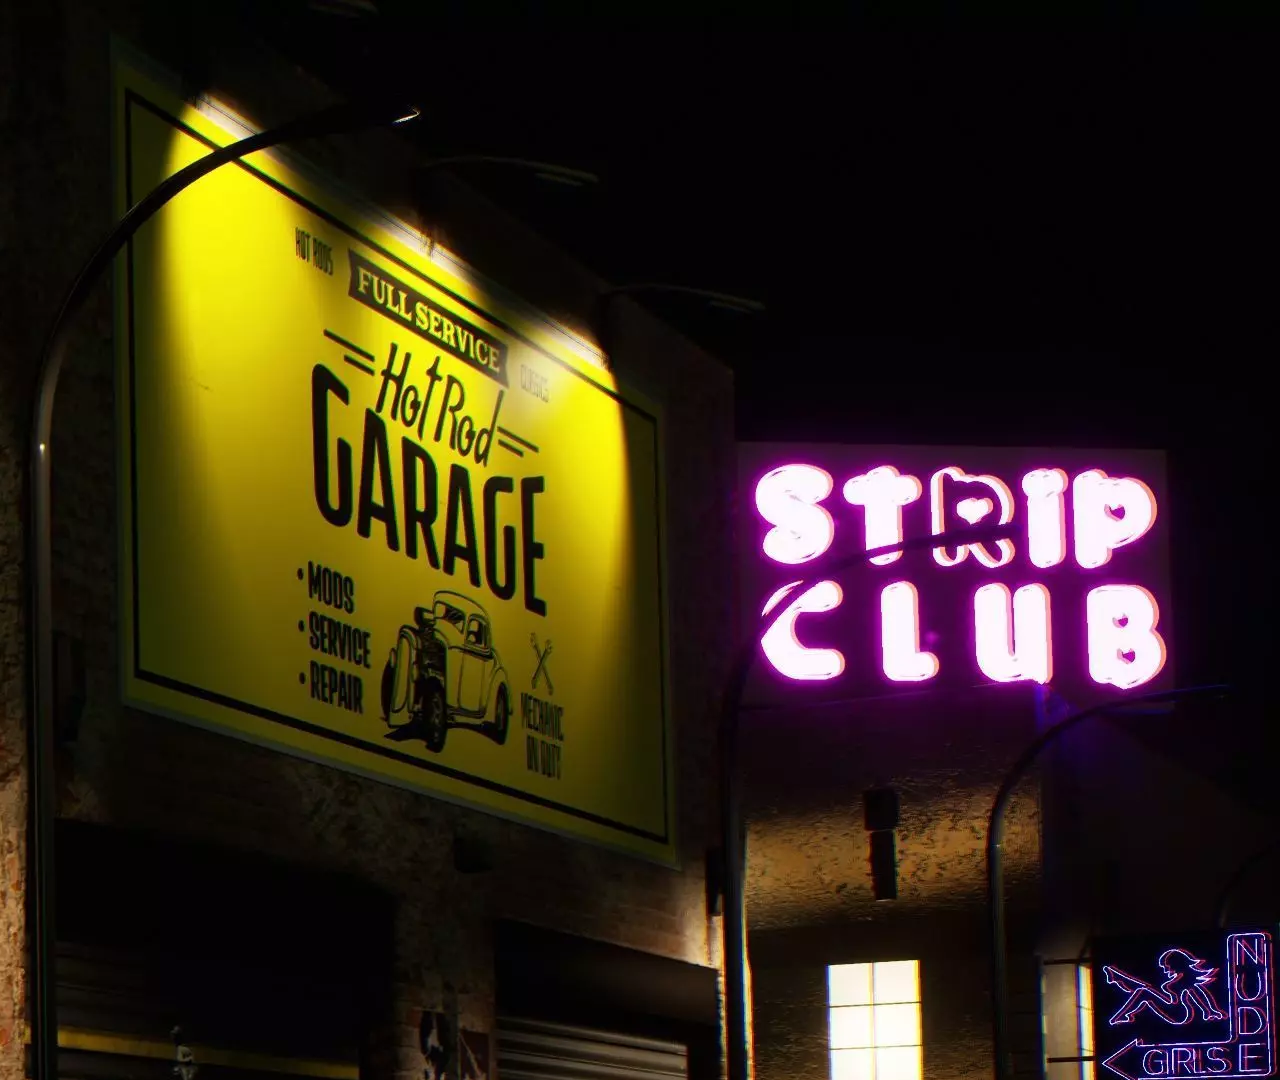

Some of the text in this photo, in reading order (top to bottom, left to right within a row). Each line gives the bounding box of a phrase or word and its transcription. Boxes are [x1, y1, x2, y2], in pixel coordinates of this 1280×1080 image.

[295, 226, 311, 262] HOT
[357, 265, 501, 374] FULL SERVICE
[375, 341, 505, 468] Hot Rod
[311, 362, 547, 617] GARAGE
[755, 462, 1158, 569] STRIP
[307, 560, 355, 615] MODS
[308, 610, 372, 670] SERVICE
[760, 579, 1168, 690] CLUB
[309, 659, 365, 715] REPAIR
[1235, 938, 1267, 1073] NUDE
[1142, 1047, 1230, 1075] GIRLS
